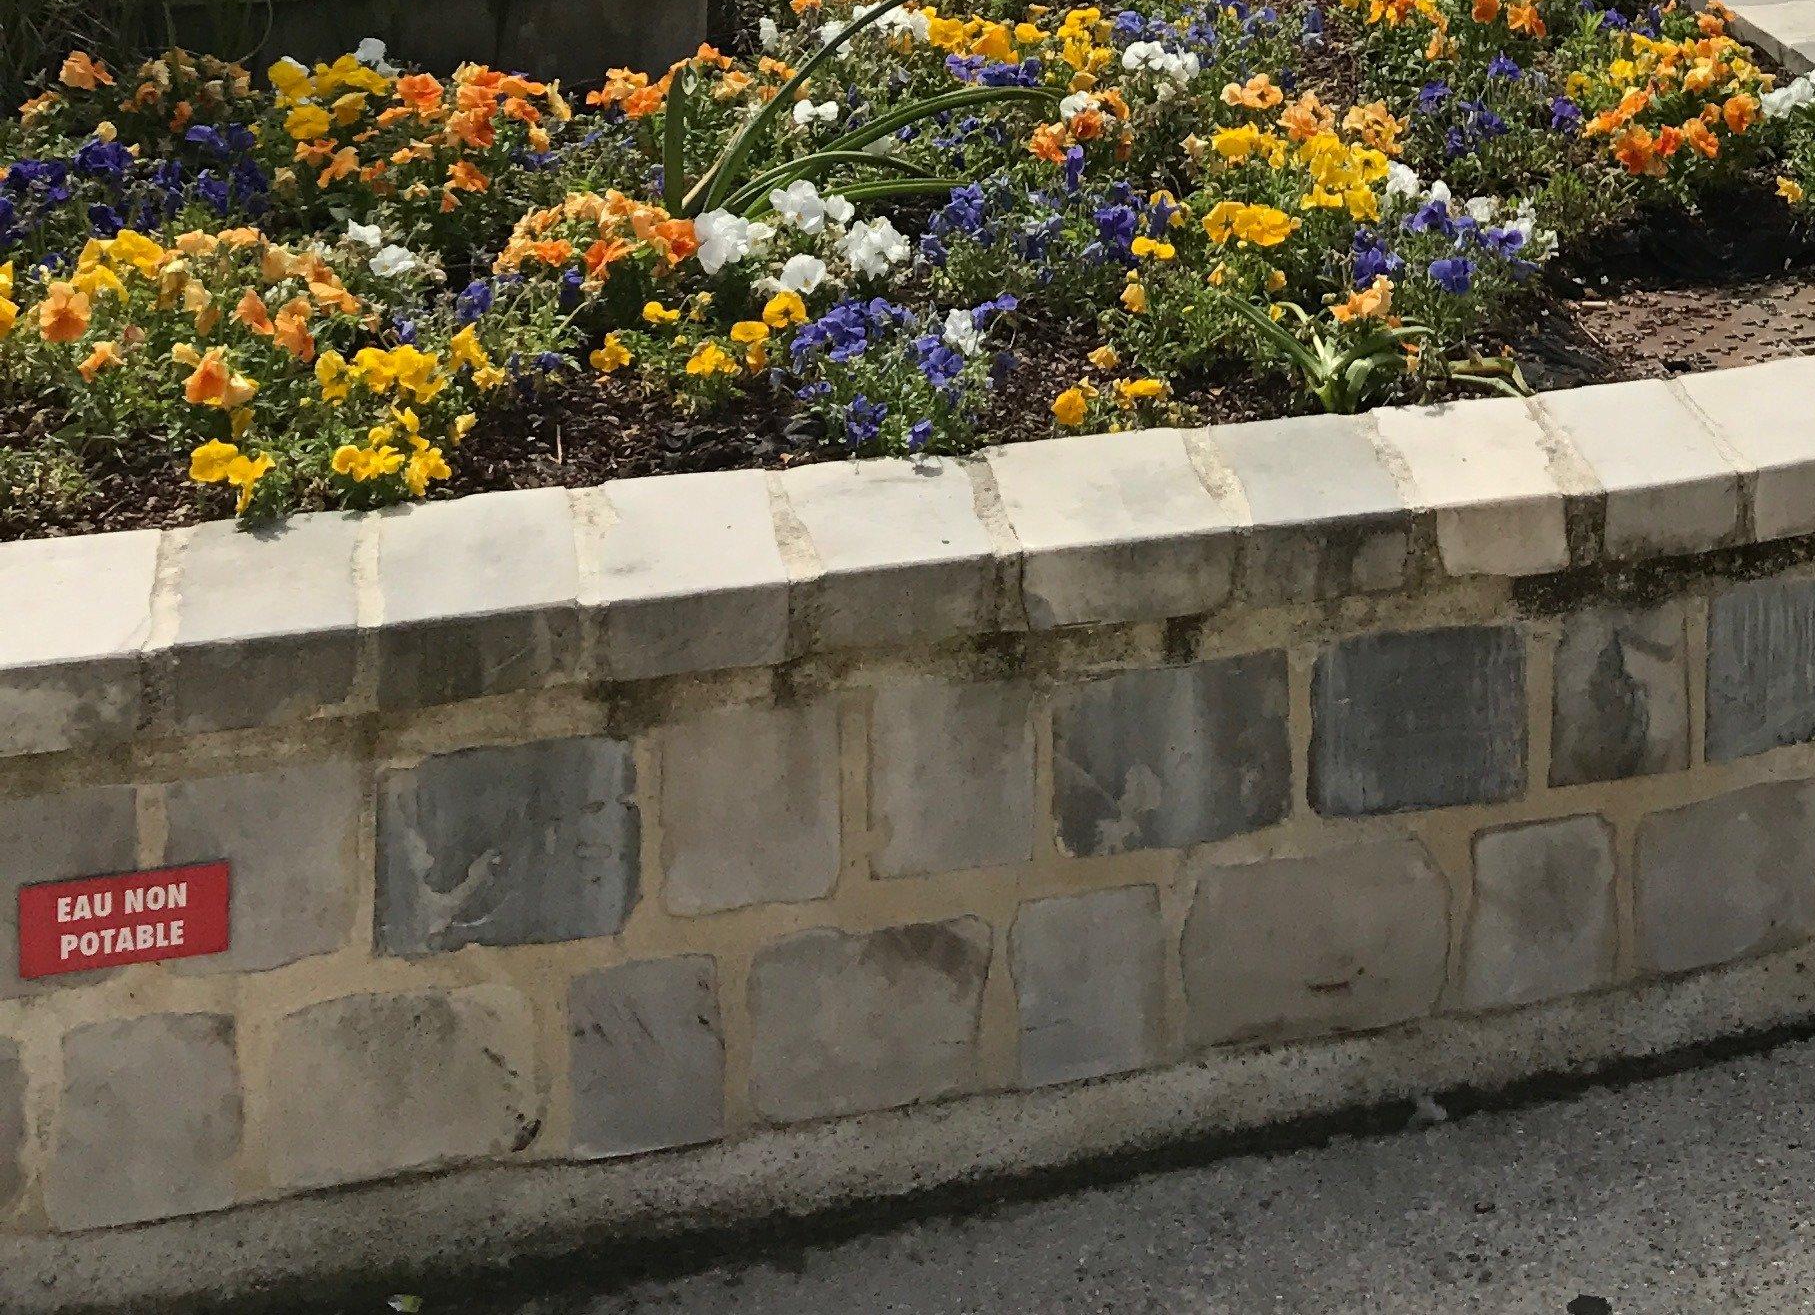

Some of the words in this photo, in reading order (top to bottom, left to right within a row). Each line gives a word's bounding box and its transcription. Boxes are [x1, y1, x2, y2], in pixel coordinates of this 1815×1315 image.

[57, 891, 113, 923] EAU
[124, 881, 188, 915] NON
[60, 919, 184, 960] POTABLE
